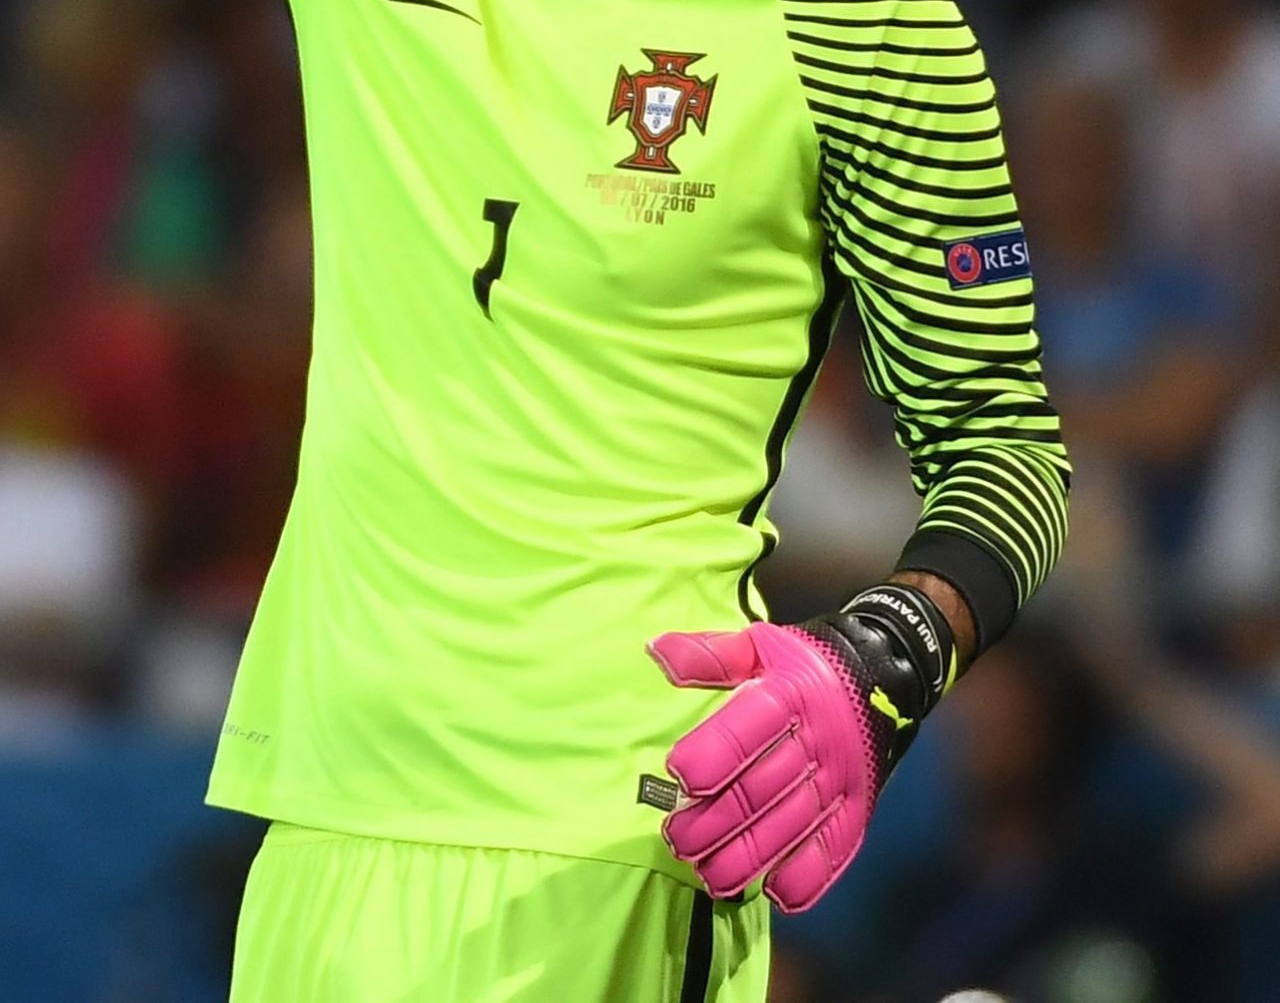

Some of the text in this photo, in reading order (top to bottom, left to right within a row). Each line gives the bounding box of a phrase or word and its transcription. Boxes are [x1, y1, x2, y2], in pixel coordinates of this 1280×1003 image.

[683, 181, 716, 199] GALES
[472, 198, 520, 323] 1
[853, 593, 937, 653] RUI PATRIC
